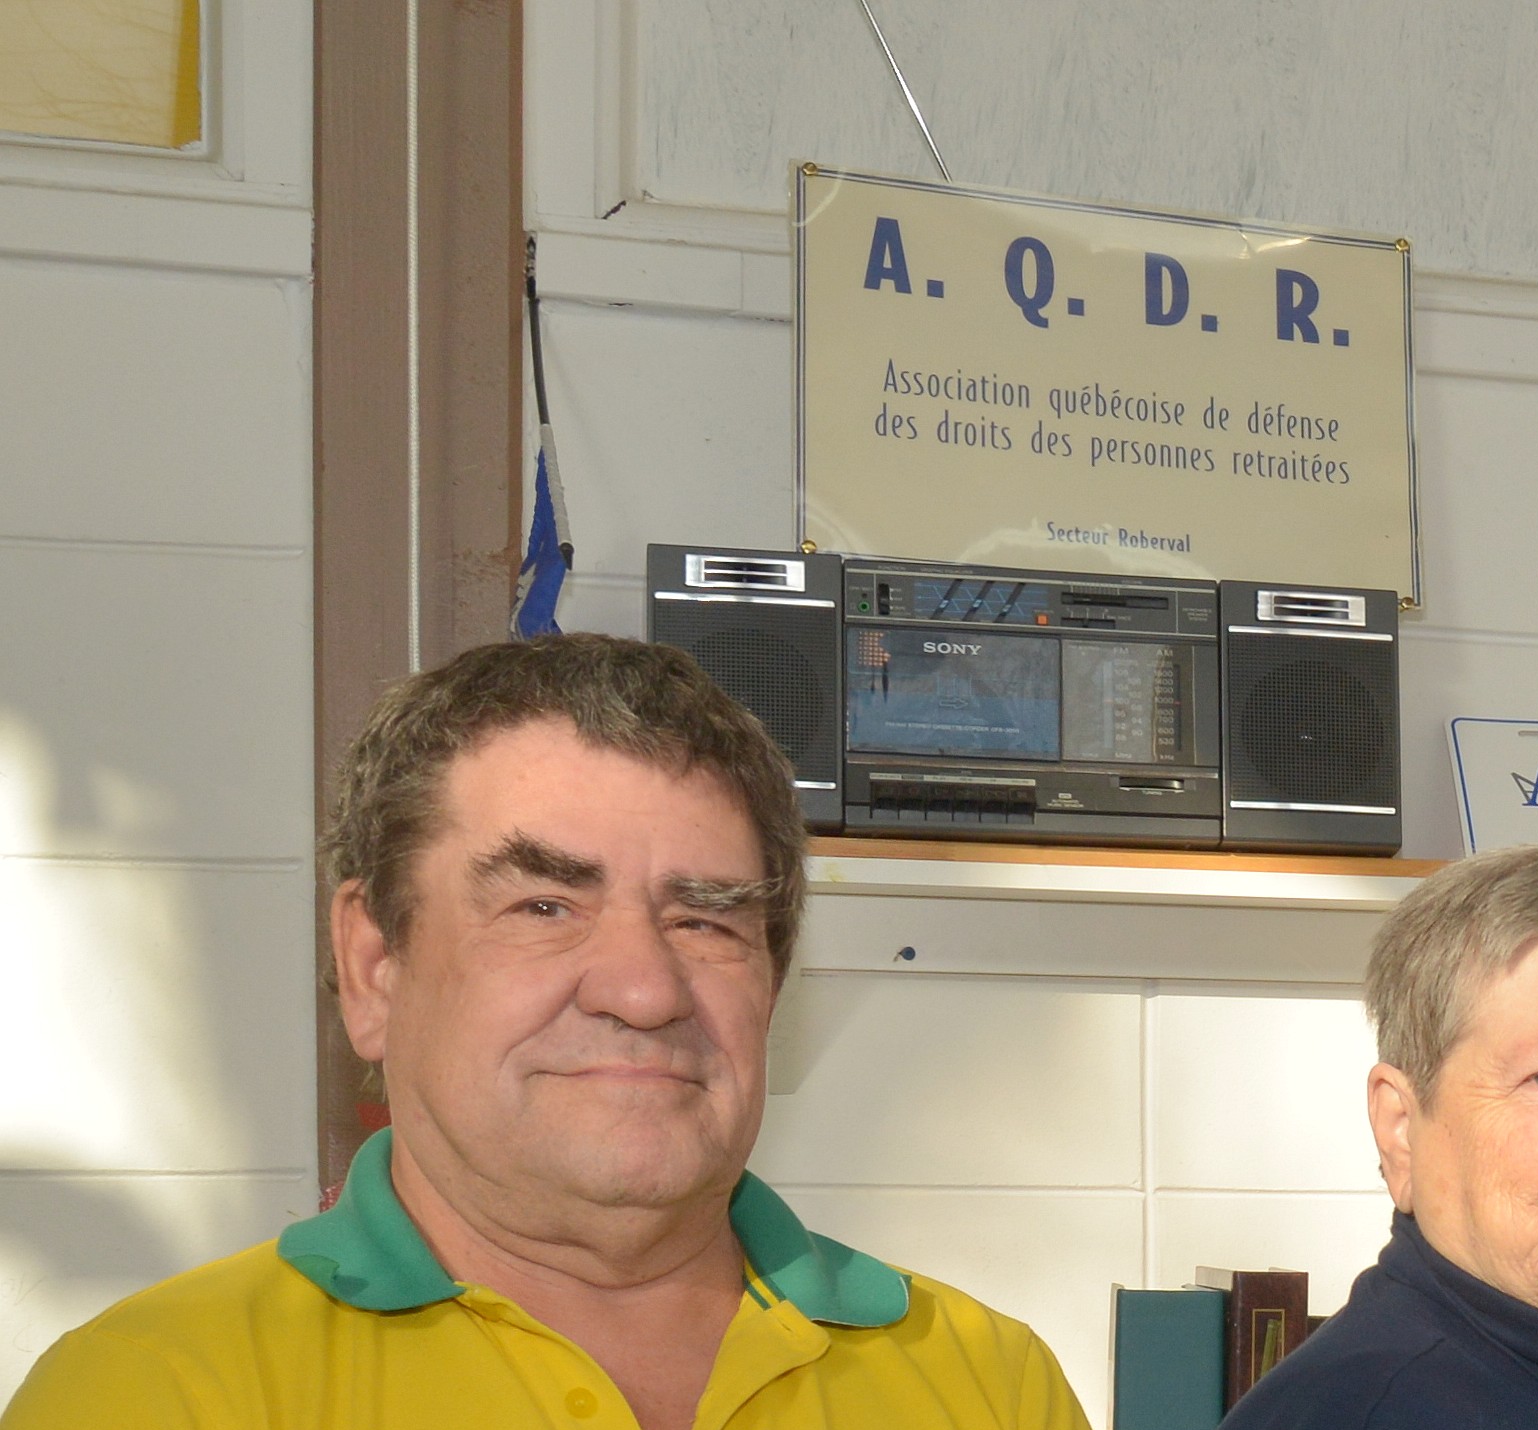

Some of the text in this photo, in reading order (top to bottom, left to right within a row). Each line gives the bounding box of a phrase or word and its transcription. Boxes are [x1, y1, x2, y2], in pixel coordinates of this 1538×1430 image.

[863, 216, 1350, 347] A. Q. D. R.
[883, 358, 1339, 441] Association québécoise de défense
[875, 402, 1350, 485] des droits des personnes retraitées
[1046, 521, 1191, 552] Secteur Roberval
[923, 641, 982, 656] SONY
[1156, 648, 1174, 657] AM
